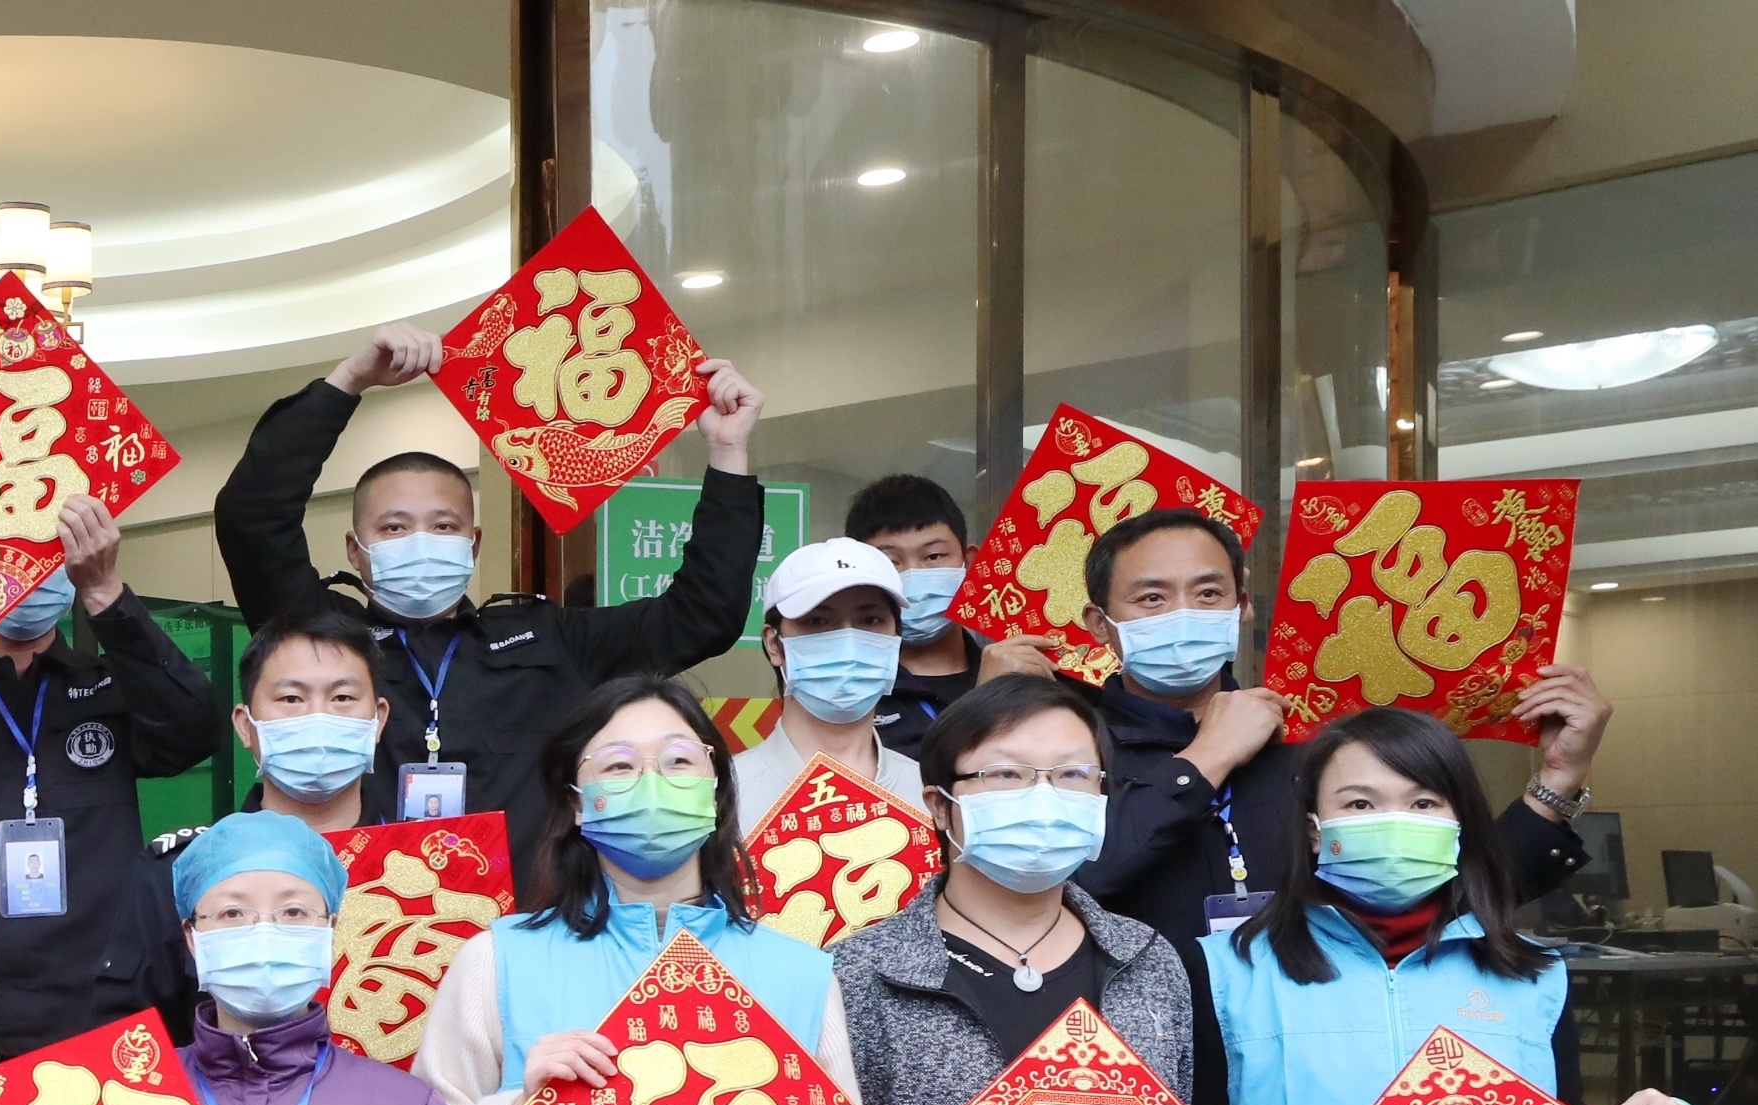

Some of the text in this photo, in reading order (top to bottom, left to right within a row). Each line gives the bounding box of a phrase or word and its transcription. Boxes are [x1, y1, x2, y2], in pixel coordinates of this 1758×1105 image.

[503, 268, 652, 426] 福
[100, 425, 145, 472] 福
[980, 582, 1026, 621] 福
[1287, 488, 1523, 706] 福
[799, 771, 849, 813] 五
